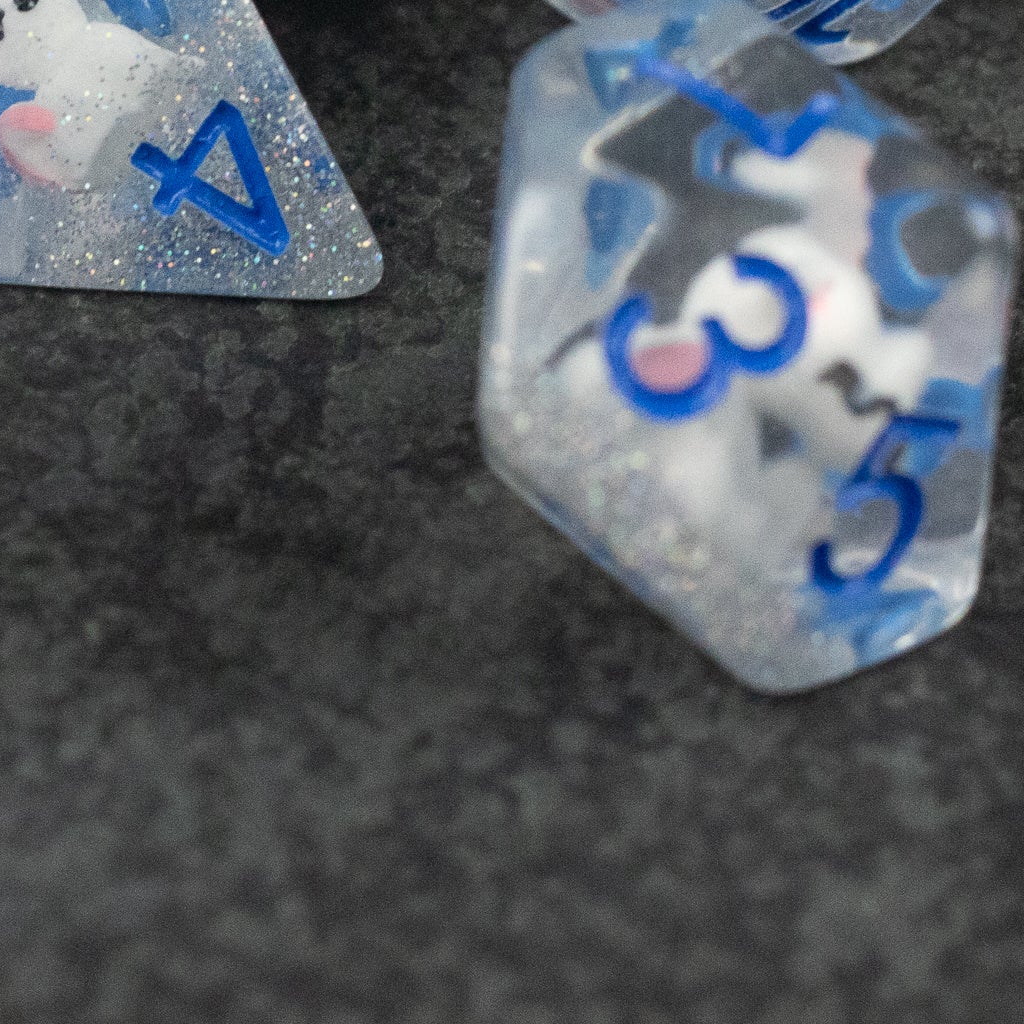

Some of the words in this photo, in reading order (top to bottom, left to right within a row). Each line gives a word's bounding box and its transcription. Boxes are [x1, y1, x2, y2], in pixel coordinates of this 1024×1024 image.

[130, 99, 291, 257] 4
[604, 253, 808, 423] 3
[812, 414, 960, 596] 5
